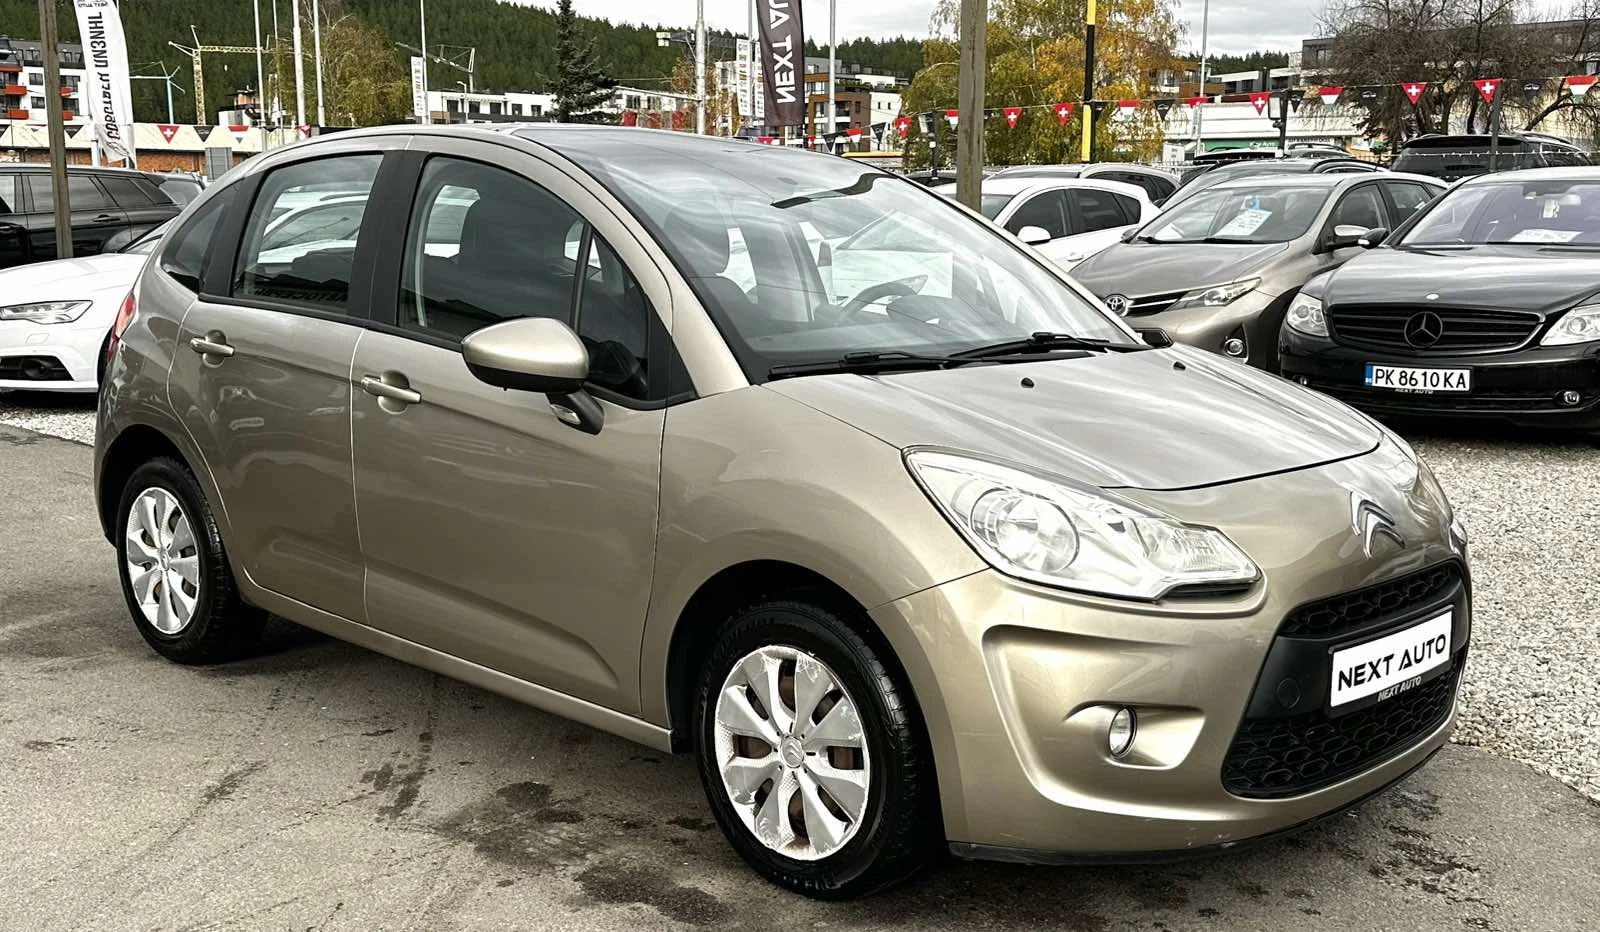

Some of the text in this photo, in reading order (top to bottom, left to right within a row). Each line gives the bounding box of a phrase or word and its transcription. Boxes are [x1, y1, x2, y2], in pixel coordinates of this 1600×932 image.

[1374, 368, 1394, 387] PK
[1398, 370, 1440, 388] 8610
[1443, 371, 1467, 389] KA
[1338, 633, 1447, 692] NEXT AUTO
[1377, 676, 1422, 702] NEXT AUTO
